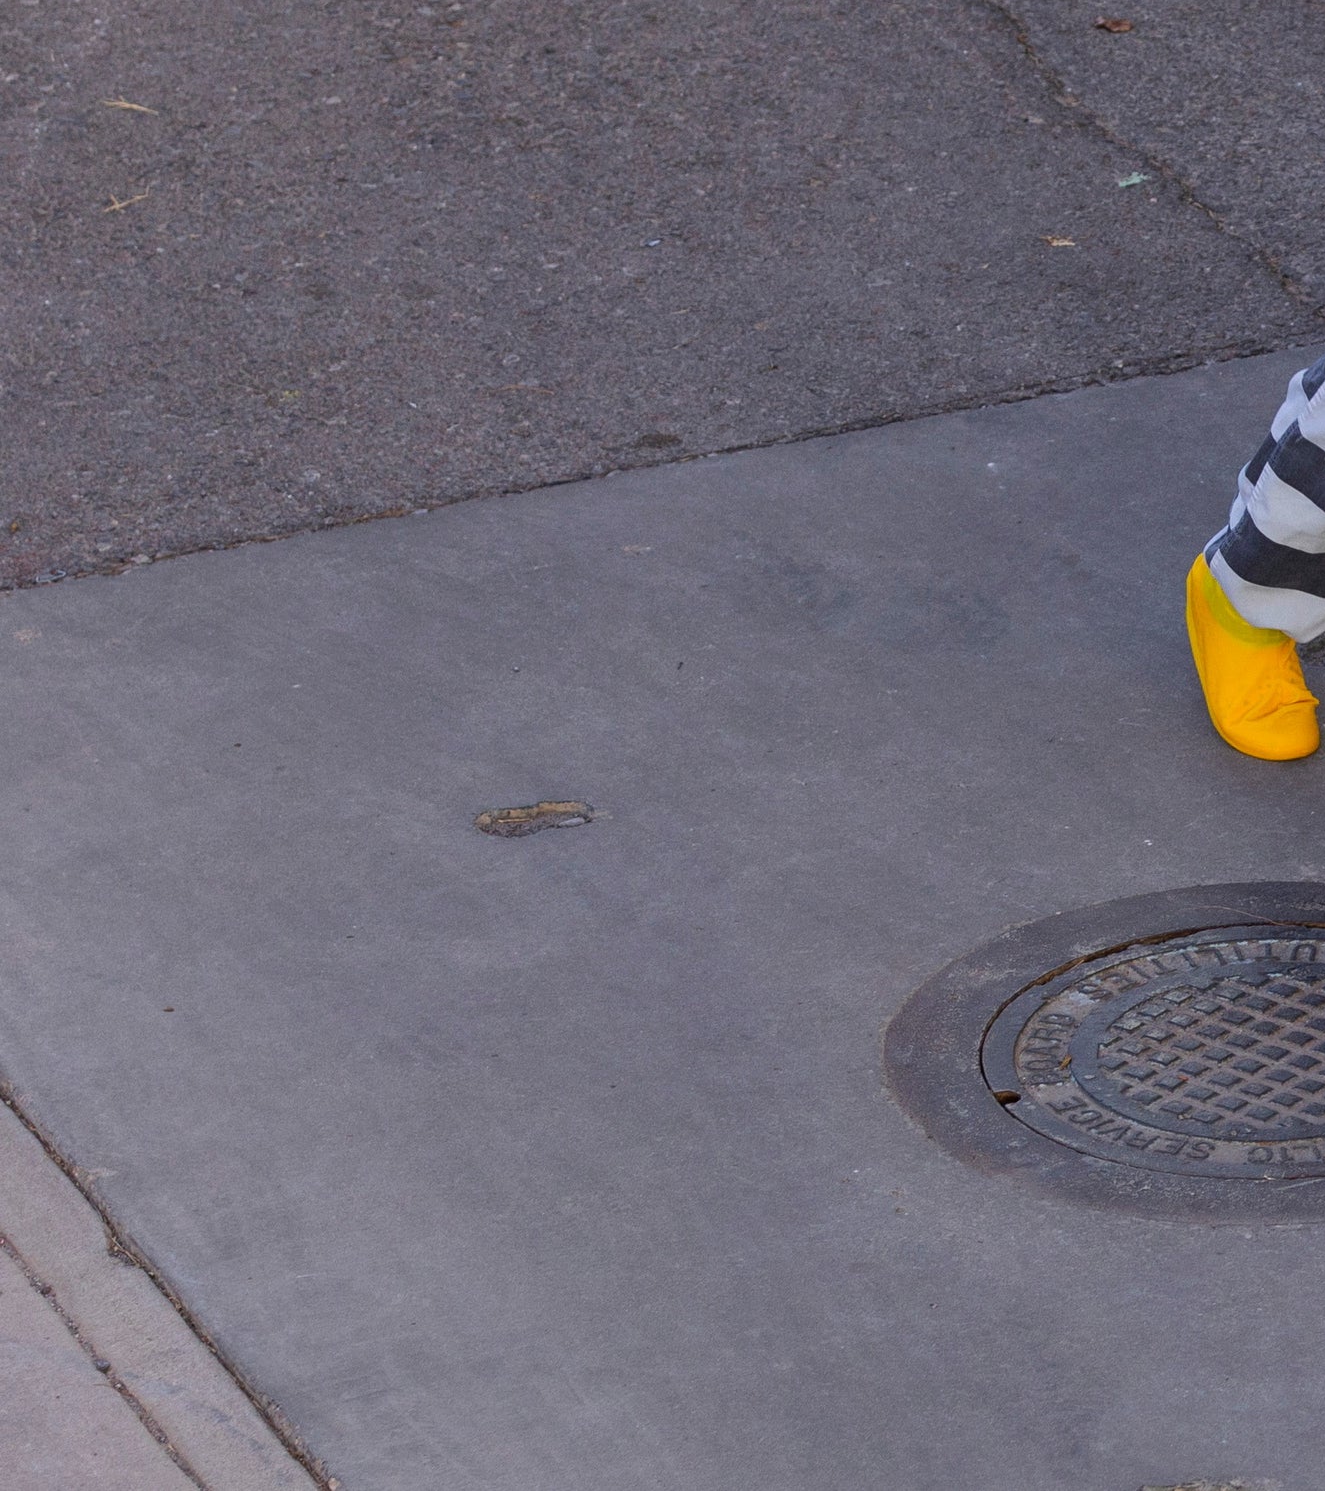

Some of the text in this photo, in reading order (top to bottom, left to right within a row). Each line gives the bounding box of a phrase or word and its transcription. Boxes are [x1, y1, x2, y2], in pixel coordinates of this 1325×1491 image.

[1077, 942, 1319, 1002] UTILITIES
[1026, 1012, 1078, 1087] BOARD
[1046, 1096, 1217, 1162] SERVICE
